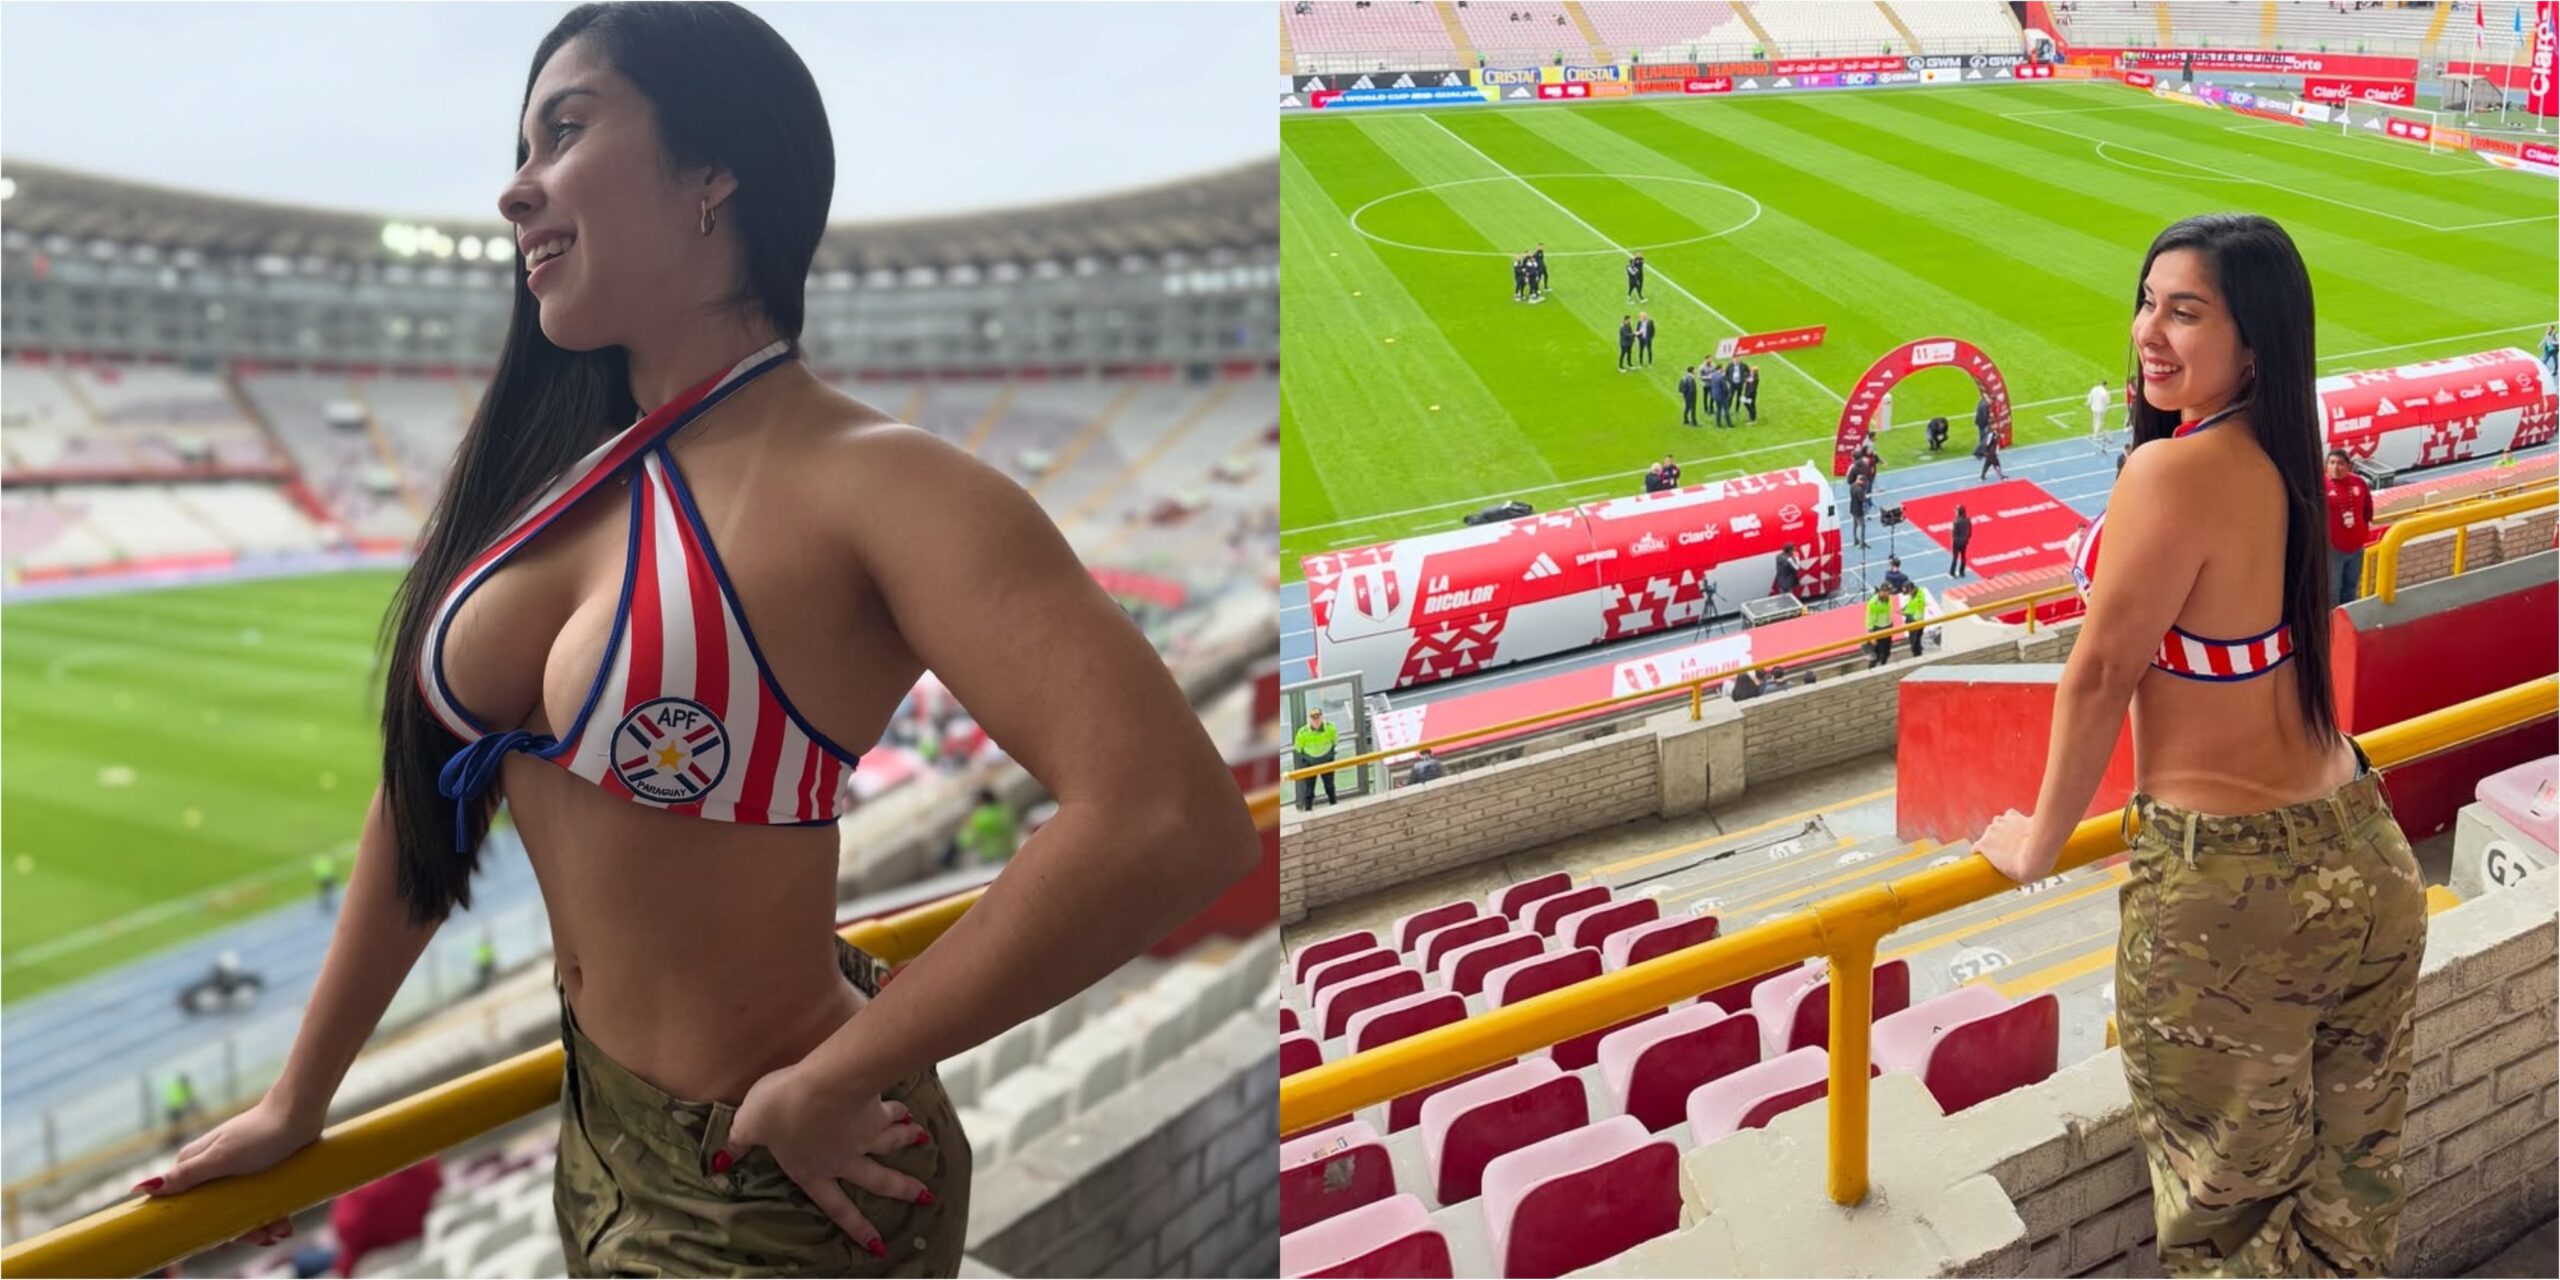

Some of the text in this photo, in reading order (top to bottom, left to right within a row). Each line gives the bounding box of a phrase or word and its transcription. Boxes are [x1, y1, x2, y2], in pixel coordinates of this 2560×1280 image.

[1926, 58, 1961, 68] GWM
[1988, 57, 2024, 67] GWM
[1485, 70, 1537, 85] CRISTAL
[1566, 68, 1615, 83] CRISTAL
[1388, 93, 1410, 102] CUP
[2312, 84, 2352, 98] Claro
[2364, 85, 2407, 100] Claro
[1679, 525, 1719, 545] Claro
[1428, 575, 1450, 595] LA
[1423, 584, 1497, 615] BICOLOR
[657, 706, 700, 730] APF
[636, 780, 687, 797] PARAGUAY
